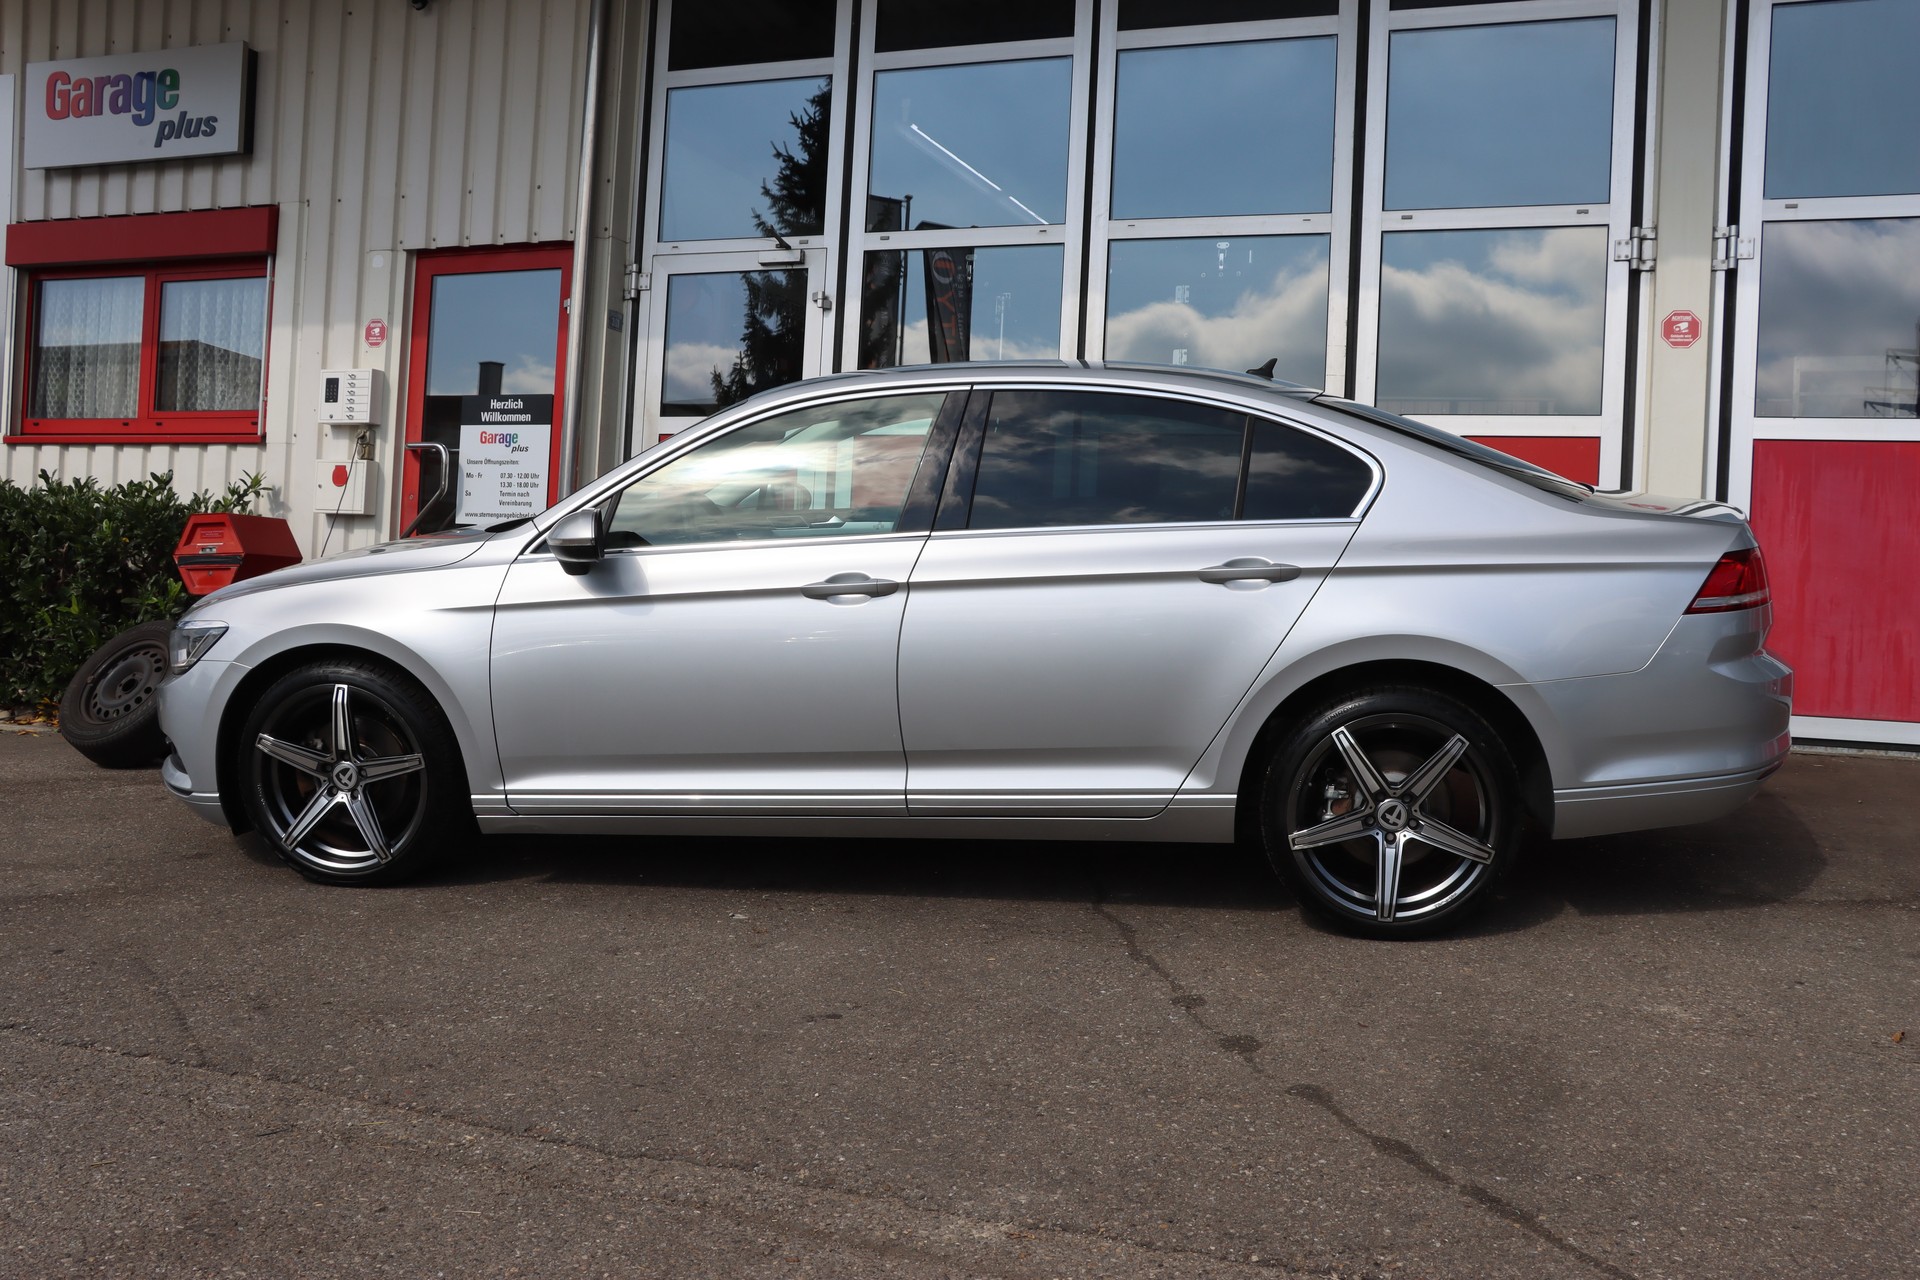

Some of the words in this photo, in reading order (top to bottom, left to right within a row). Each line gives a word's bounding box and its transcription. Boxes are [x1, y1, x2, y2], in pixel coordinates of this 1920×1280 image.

[46, 68, 180, 127] Garage
[154, 110, 218, 148] plus
[490, 399, 523, 409] Herzlich
[481, 411, 531, 422] Willkommen
[480, 431, 518, 448] Garage
[511, 444, 529, 454] plus
[484, 458, 519, 466] Öffnungszeiten:
[499, 499, 532, 508] Vereinbarung
